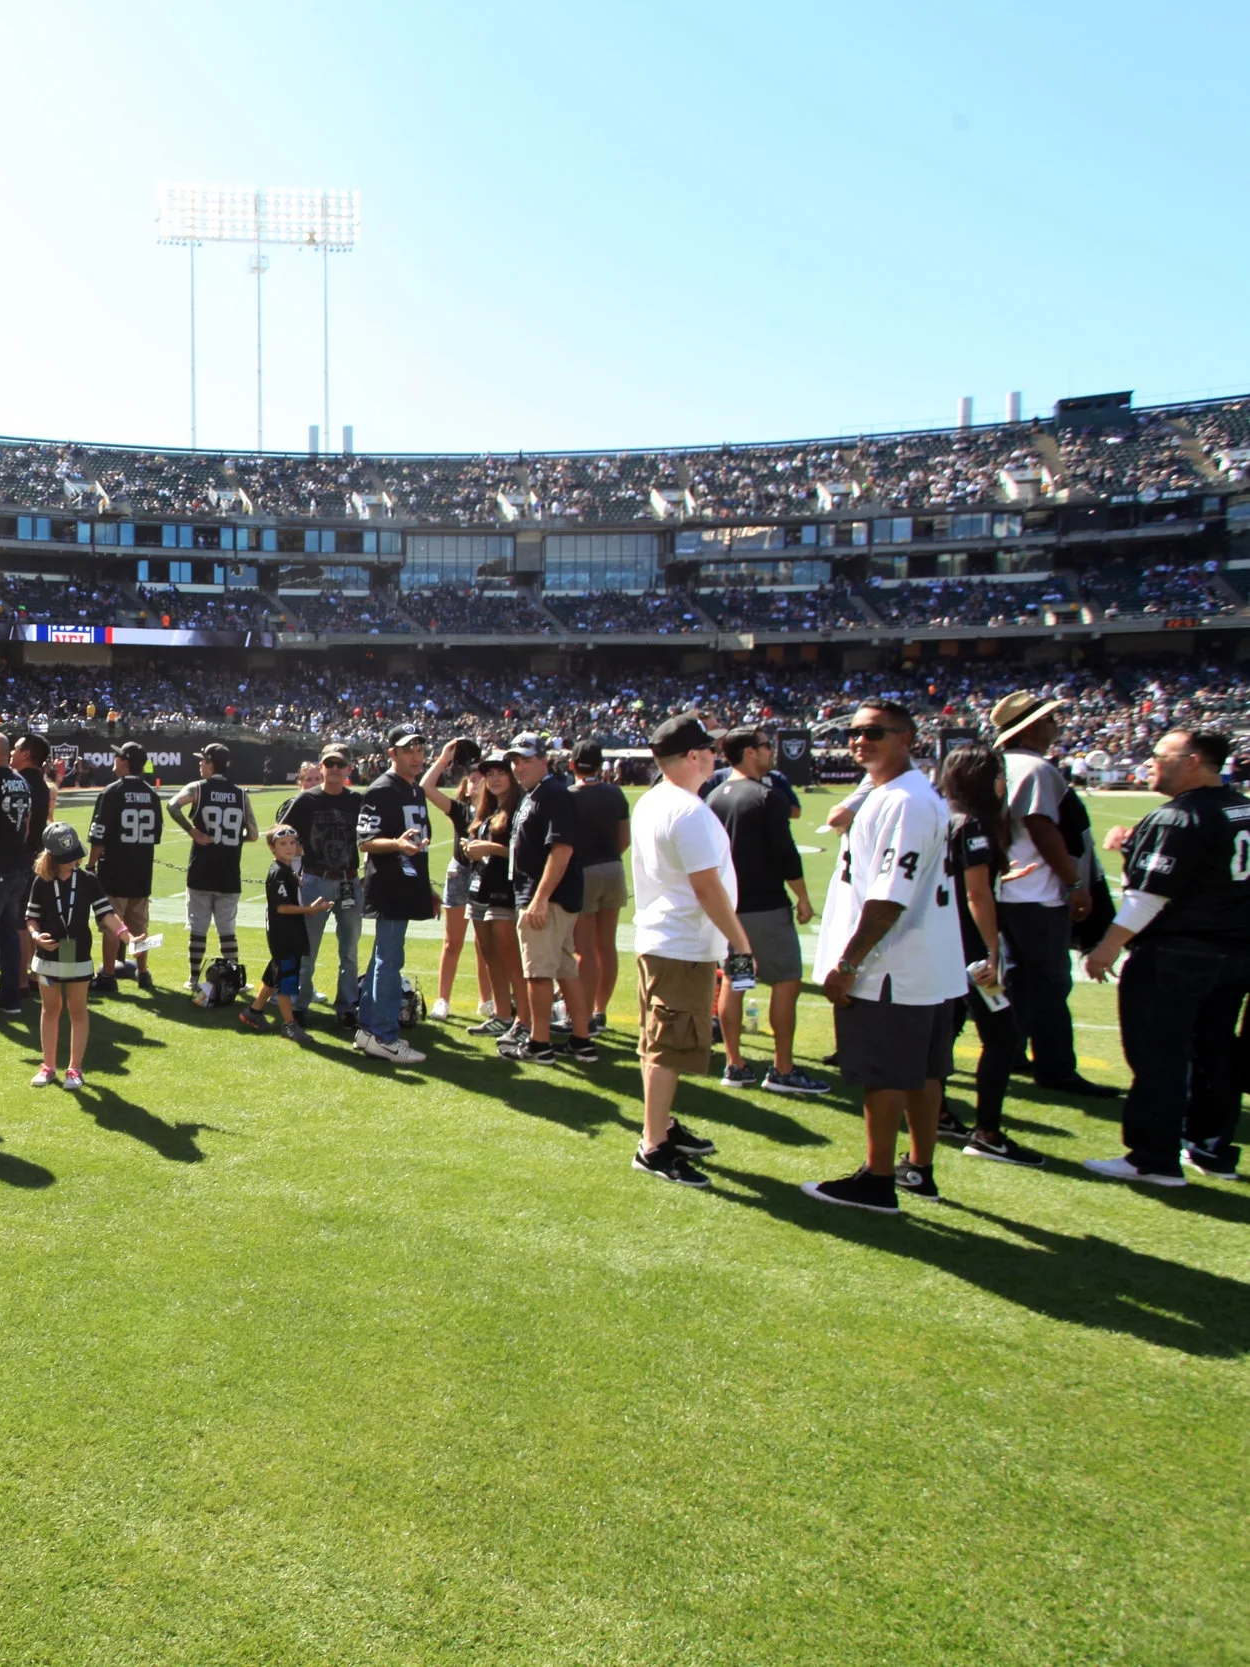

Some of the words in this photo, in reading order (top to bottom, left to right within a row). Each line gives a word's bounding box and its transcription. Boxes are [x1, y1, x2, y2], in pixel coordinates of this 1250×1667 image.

[210, 791, 237, 803] COOPER
[120, 808, 155, 844] 92
[201, 806, 243, 846] 89
[356, 813, 382, 834] 52
[881, 848, 920, 881] 34
[277, 884, 288, 897] 4
